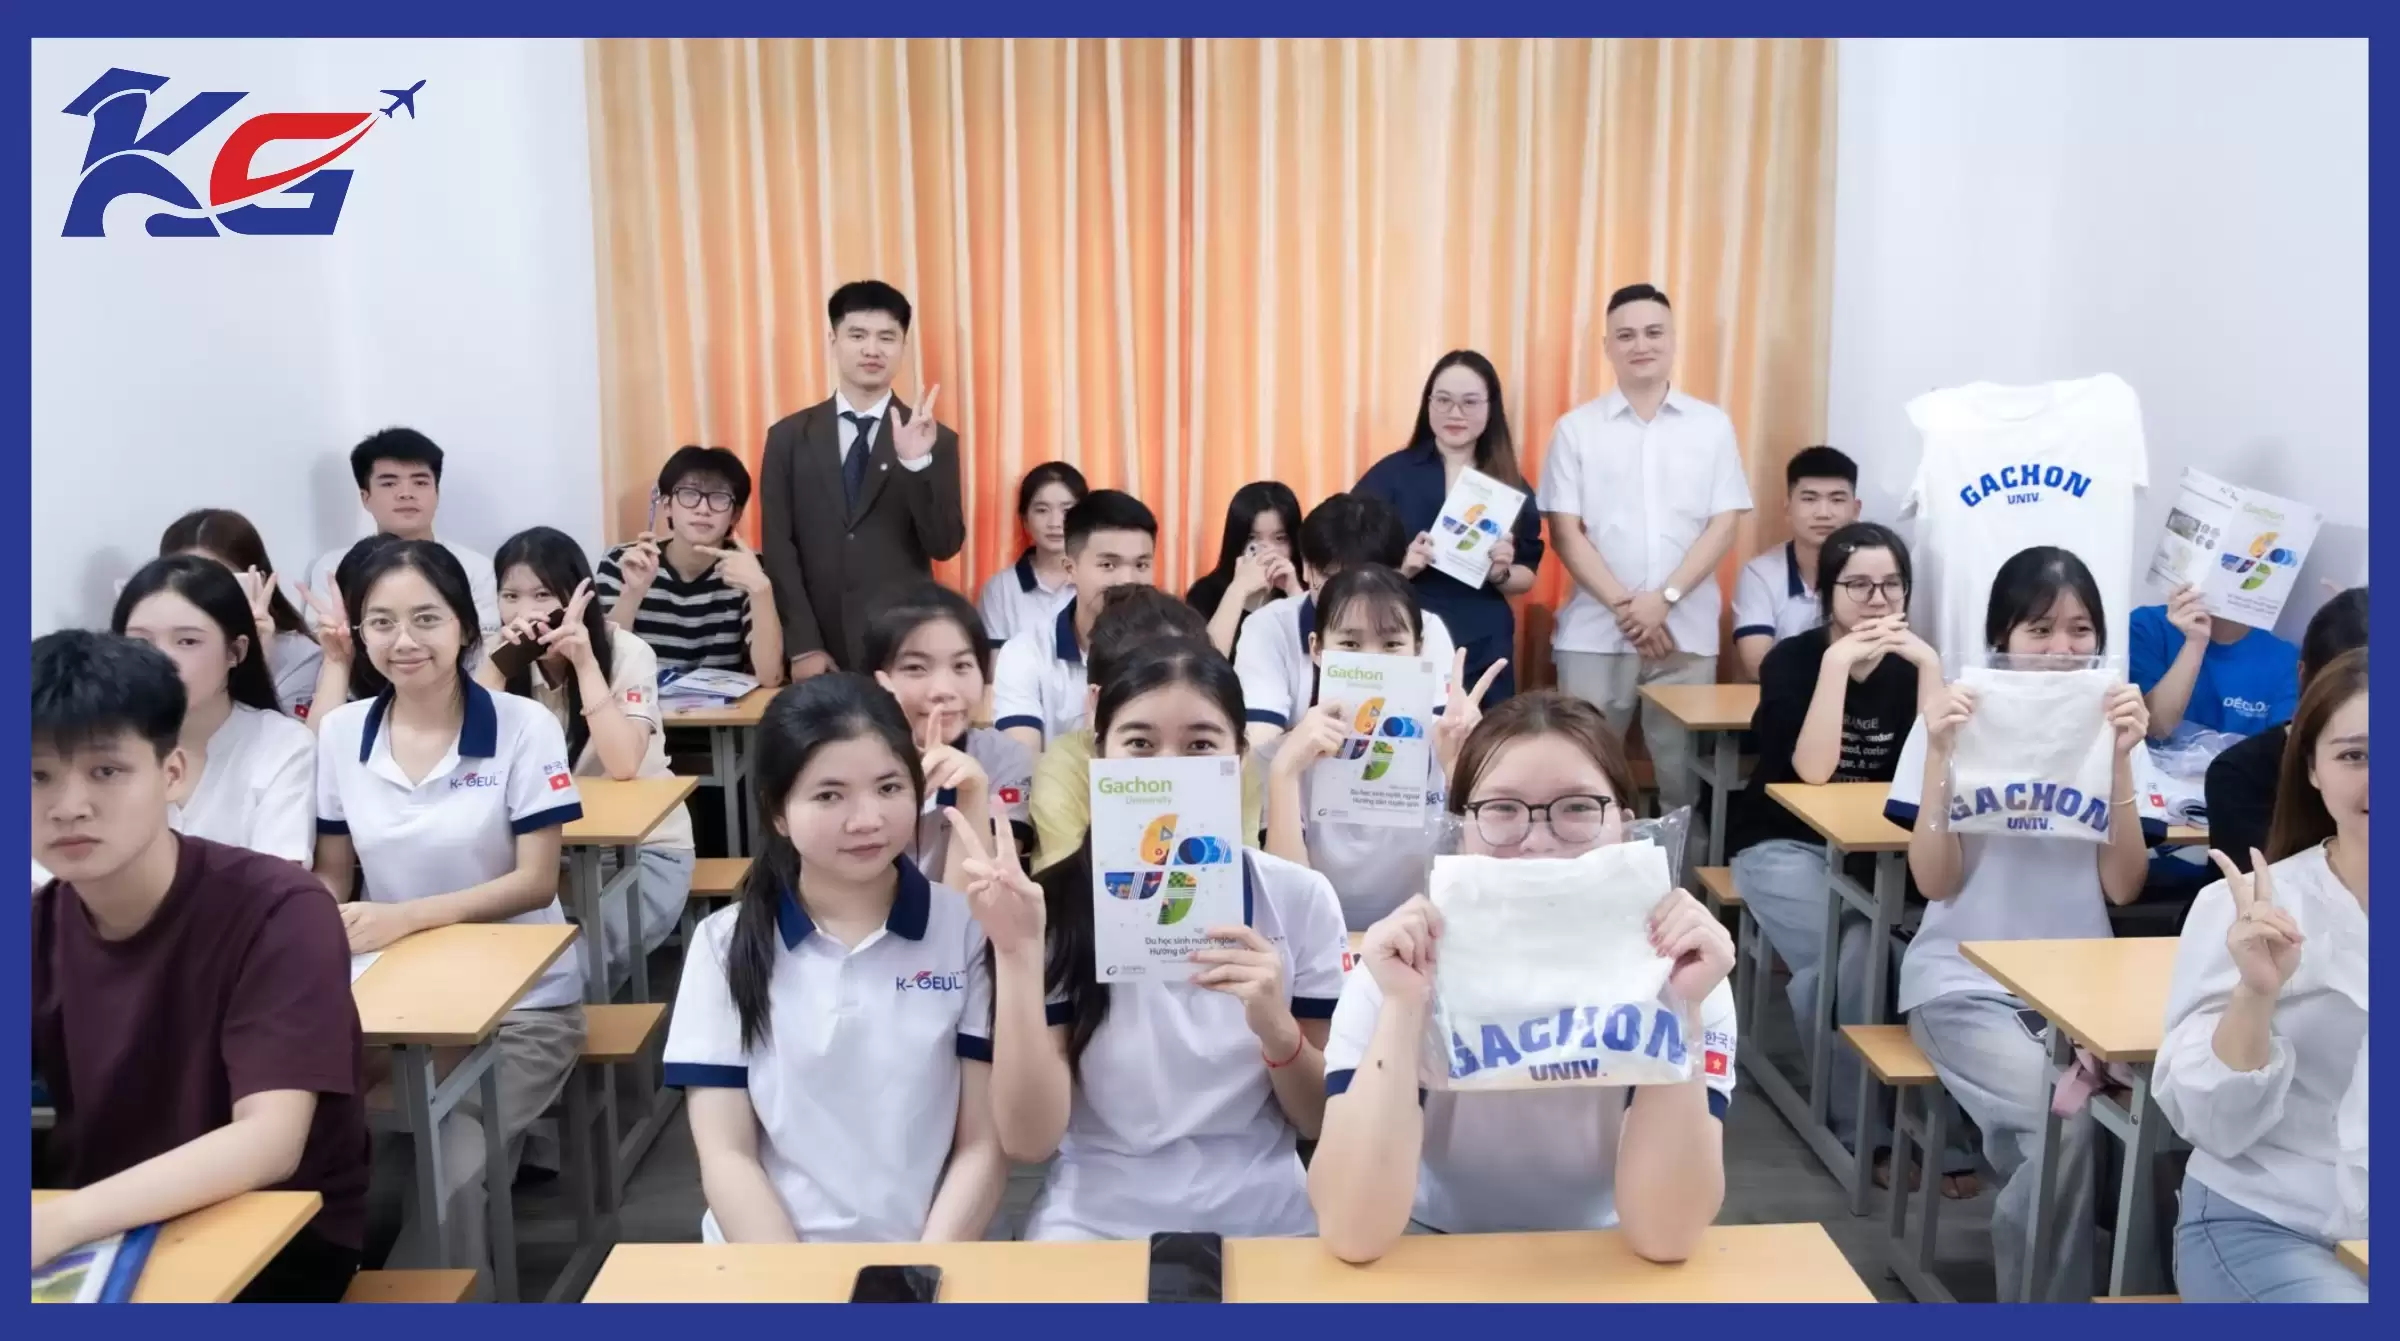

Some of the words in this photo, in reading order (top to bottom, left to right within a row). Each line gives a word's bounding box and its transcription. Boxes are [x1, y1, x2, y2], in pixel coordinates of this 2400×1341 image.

[1960, 464, 2092, 507] GACHON
[1327, 664, 1383, 681] Gachon
[1844, 714, 1879, 729] RANGE
[1098, 776, 1172, 794] Gachon
[1950, 783, 2109, 833] GACHON
[2007, 817, 2054, 831] UNIV.
[1174, 936, 1190, 945] sinh
[1528, 1058, 1608, 1081] UNIV.
